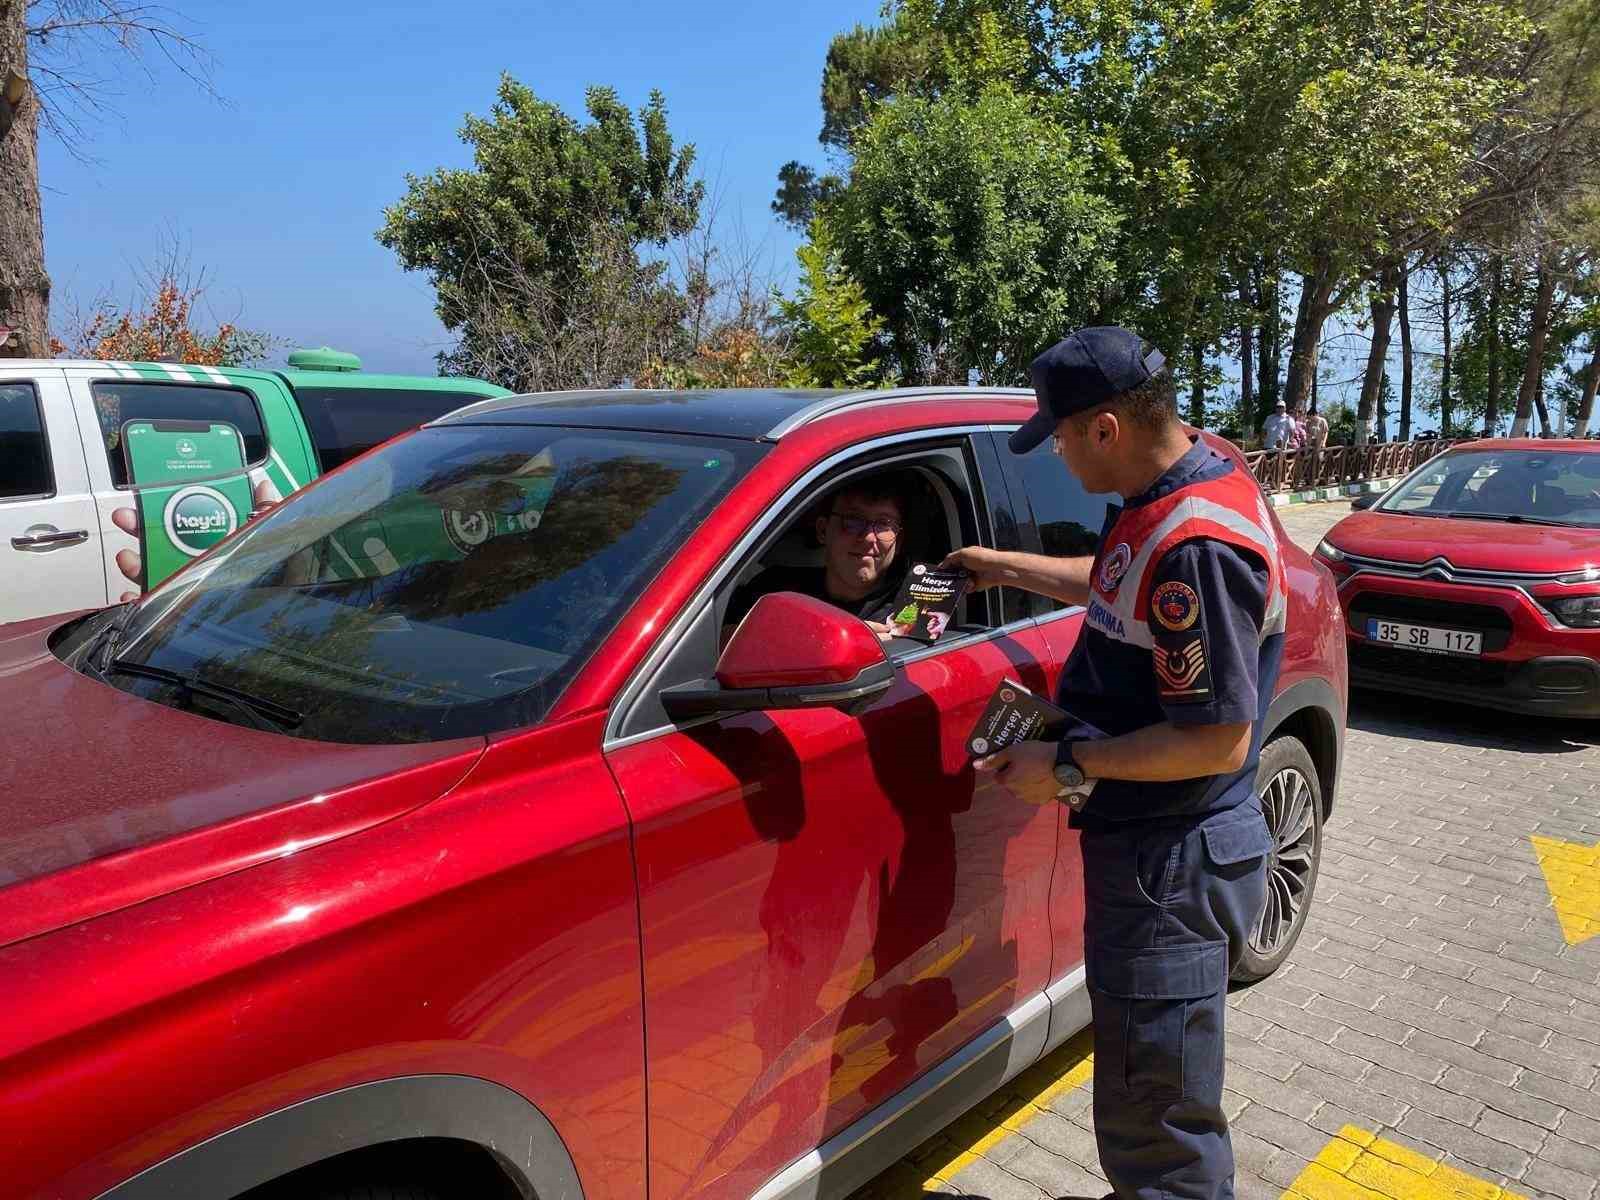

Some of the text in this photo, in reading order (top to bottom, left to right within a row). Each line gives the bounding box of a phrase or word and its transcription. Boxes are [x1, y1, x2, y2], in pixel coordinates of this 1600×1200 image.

[175, 510, 226, 530] haydi
[1380, 623, 1399, 641] 35
[1408, 627, 1430, 646] SB
[1444, 631, 1476, 652] 112
